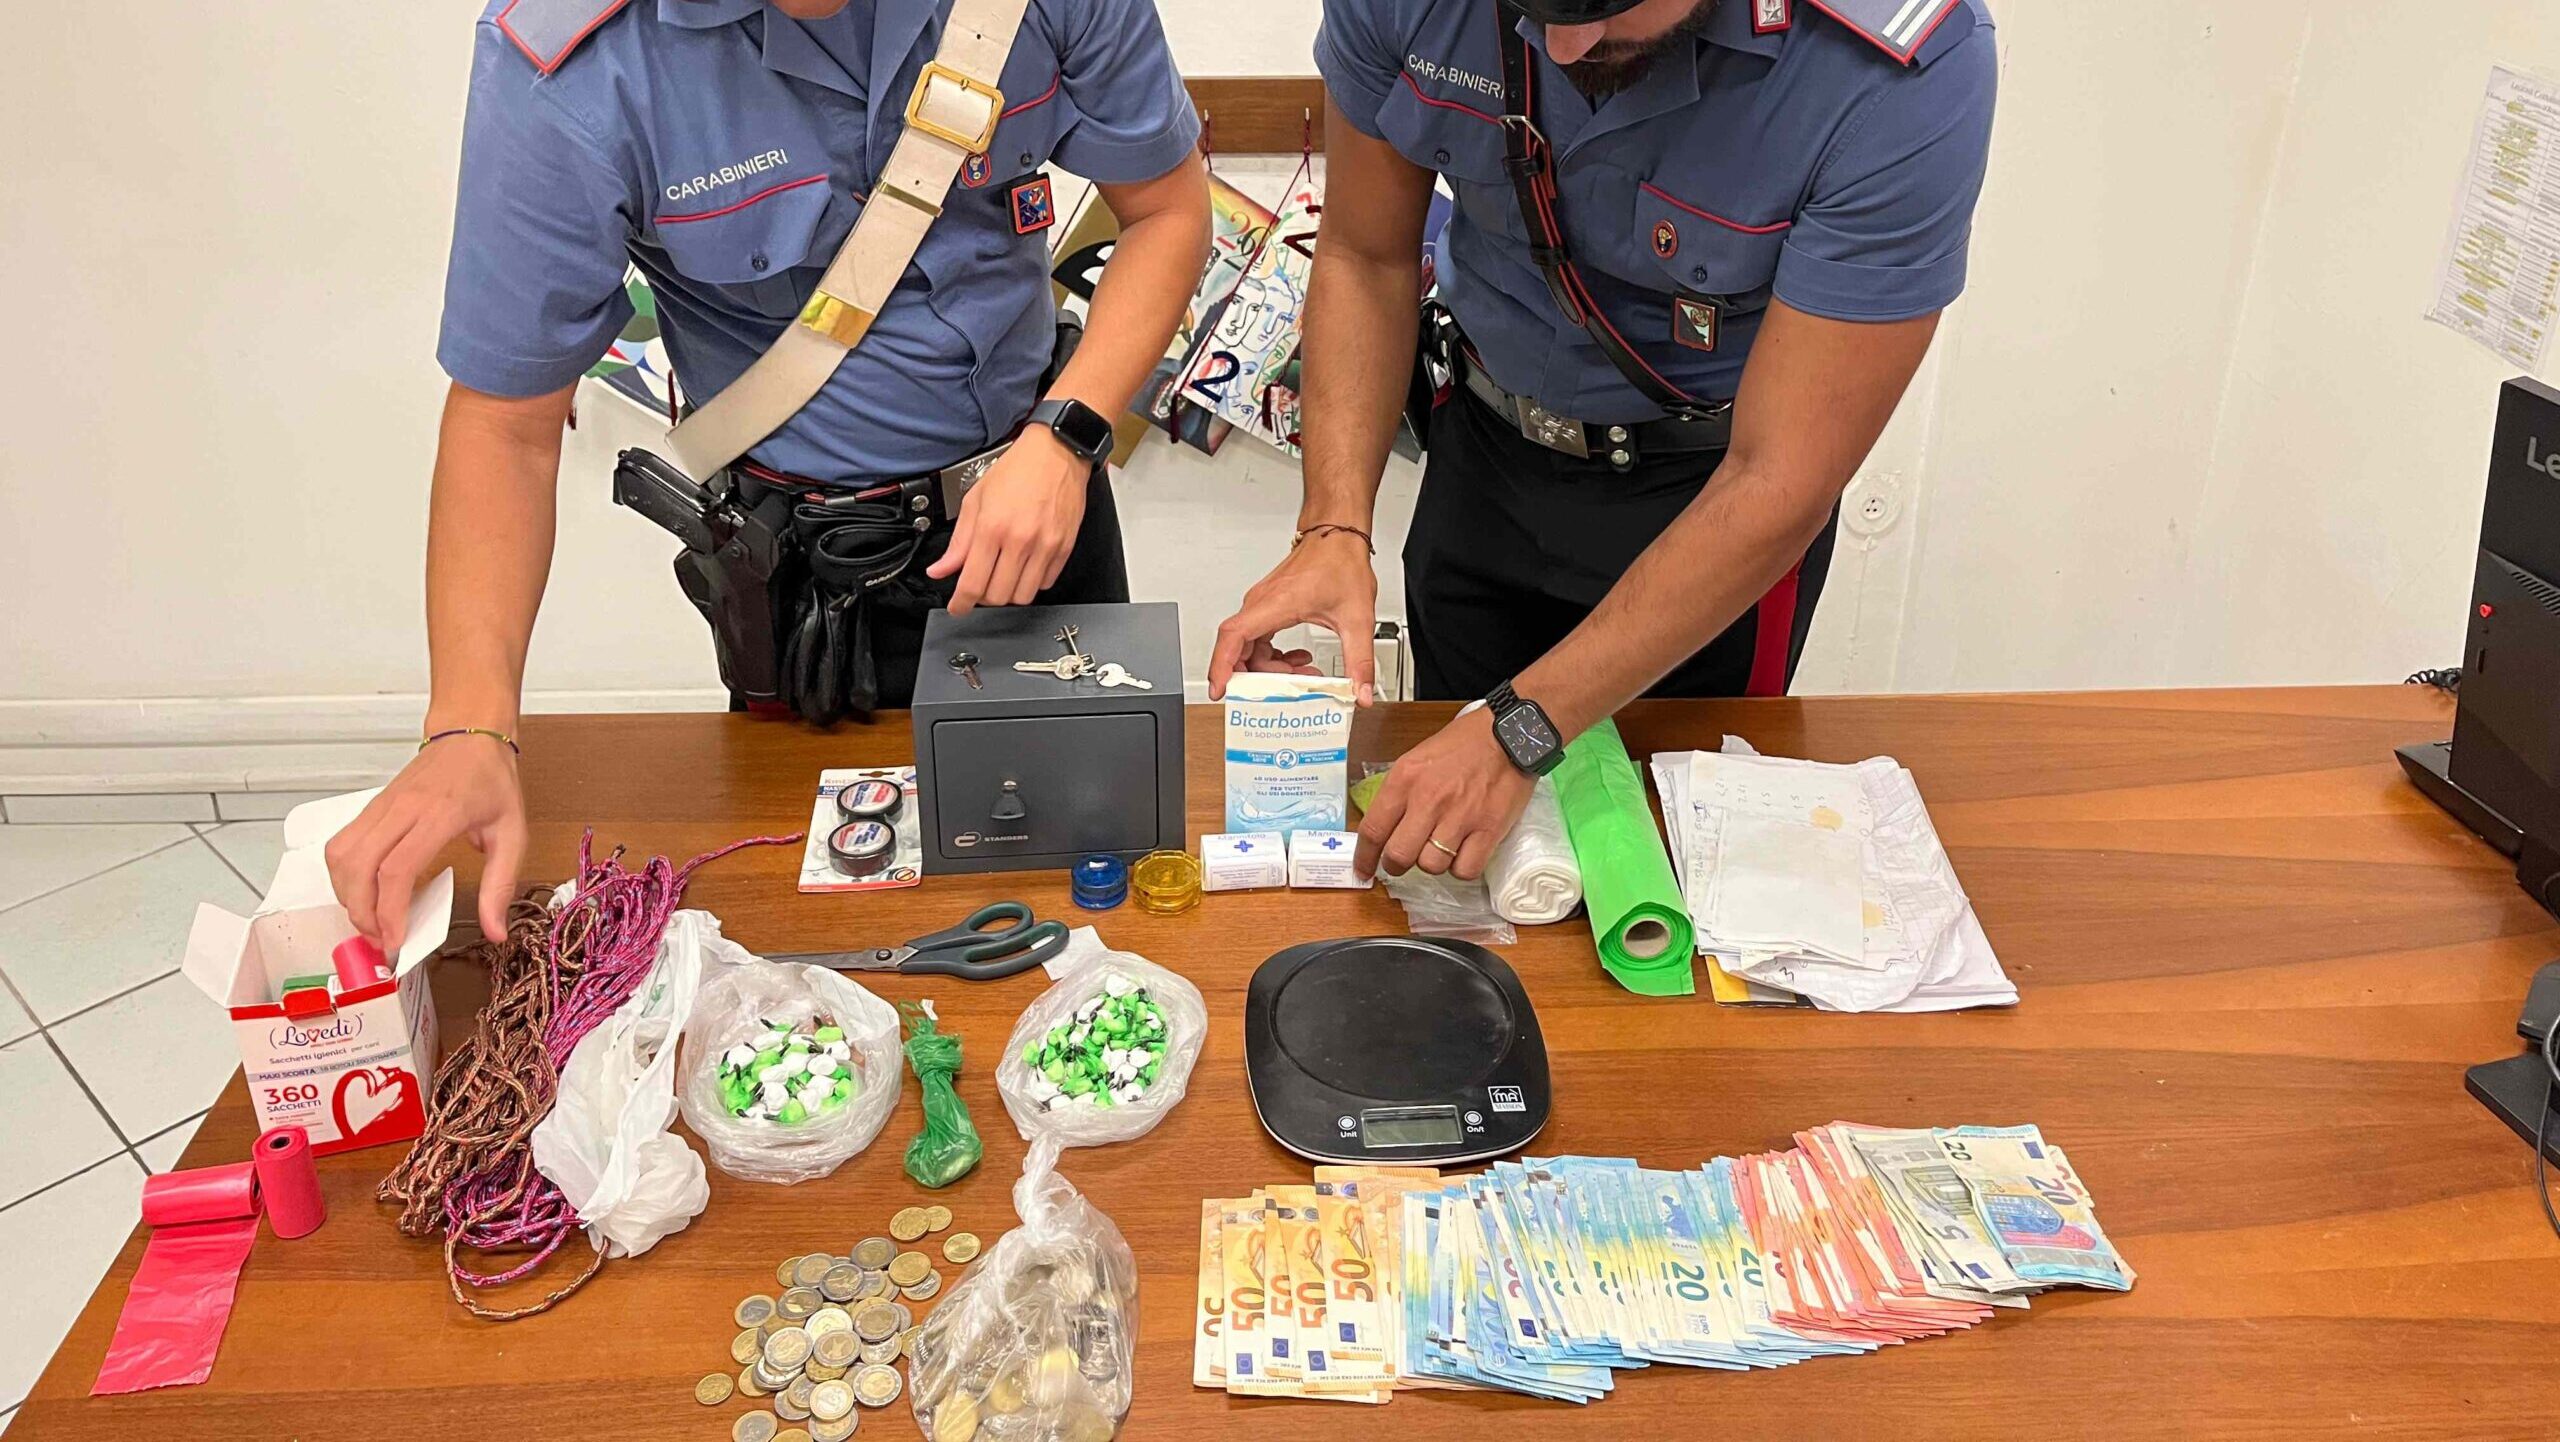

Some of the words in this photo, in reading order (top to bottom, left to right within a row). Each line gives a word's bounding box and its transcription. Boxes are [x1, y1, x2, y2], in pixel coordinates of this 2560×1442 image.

[665, 147, 789, 202] CARABINIERI
[1192, 350, 1240, 402] 2
[1230, 707, 1342, 729] Bicarbonato
[1244, 730, 1253, 738] DI
[1255, 731, 1282, 739] SODIO
[1284, 729, 1329, 739] PURISSIMO
[984, 834, 1029, 842] STANDERS
[269, 1053, 312, 1065] Sacchetti
[313, 1048, 347, 1061] igienici
[350, 1044, 364, 1053] per
[364, 1040, 380, 1049] cani
[258, 1072, 281, 1081] MAXI
[281, 1068, 316, 1079] SCORTA
[263, 1083, 319, 1106] 360
[266, 1099, 322, 1113] SACCHETTI
[1340, 1130, 1358, 1139] Unit
[1943, 1140, 1972, 1161] 20
[2026, 1176, 2078, 1206] 20
[1932, 1224, 1970, 1241] 5
[1331, 1258, 1375, 1303] 50
[1670, 1261, 1710, 1302] 20
[1231, 1286, 1265, 1332] 50
[1296, 1281, 1327, 1329] 50
